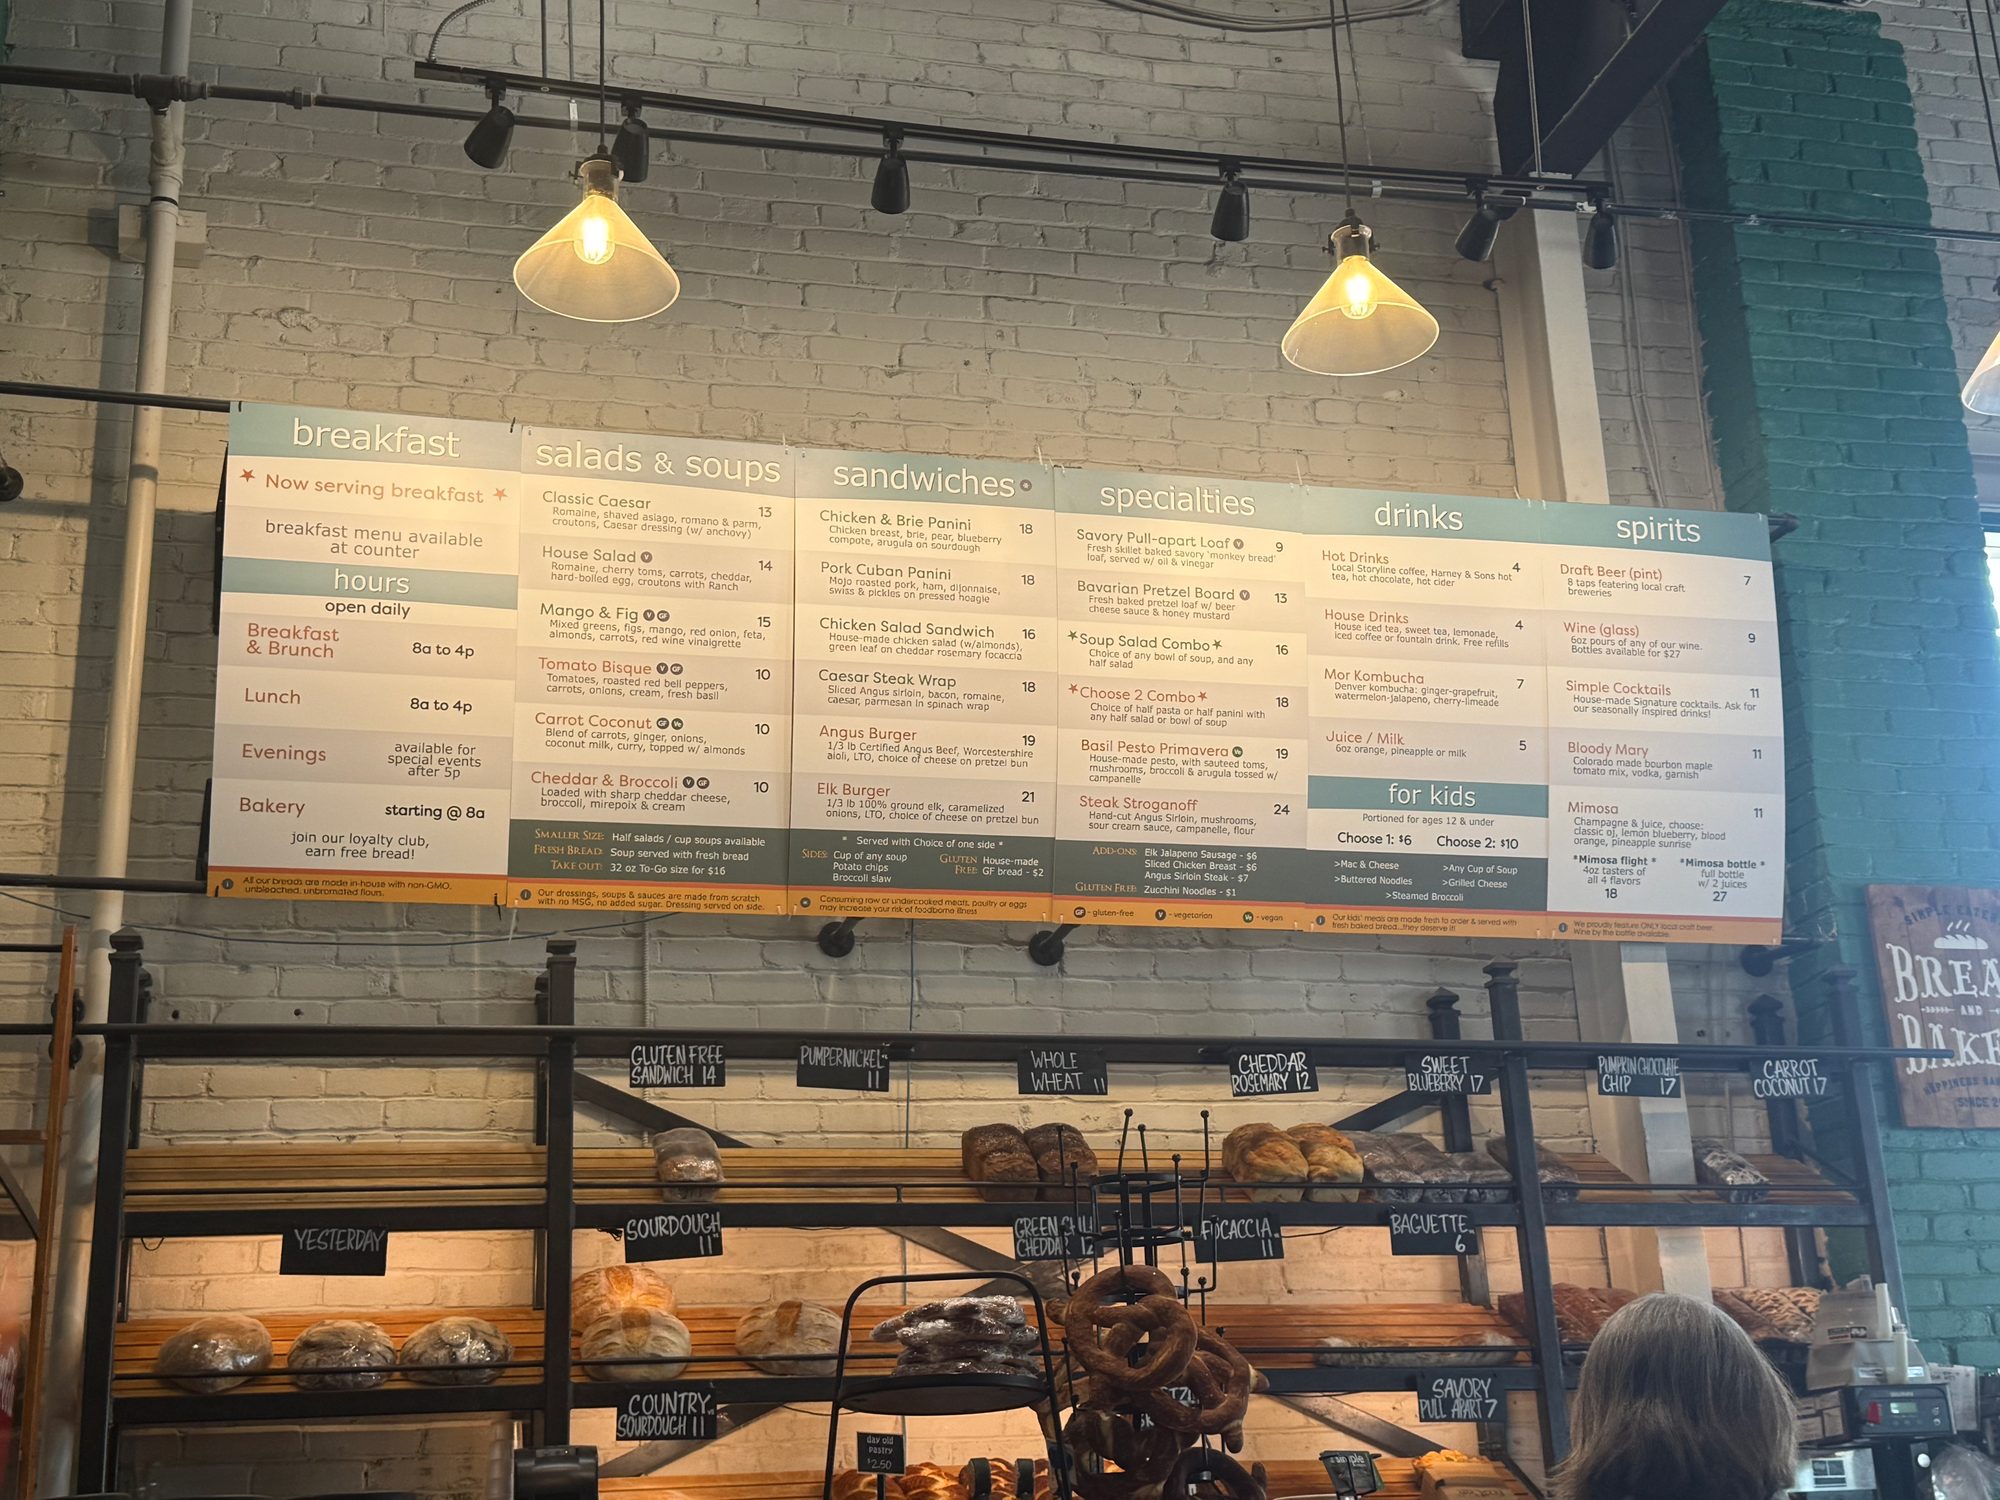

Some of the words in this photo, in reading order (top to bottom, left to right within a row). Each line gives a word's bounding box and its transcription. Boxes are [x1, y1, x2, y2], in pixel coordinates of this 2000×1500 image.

[293, 417, 460, 458] breakfast
[535, 440, 642, 473] salads
[654, 452, 675, 475] &
[686, 454, 781, 487] soups
[266, 474, 308, 490] Now
[315, 479, 384, 499] serving
[392, 483, 484, 503] breakfast
[833, 464, 1016, 498] sandwiches
[543, 491, 594, 506] Classic
[598, 495, 651, 509] Caesar
[1100, 485, 1256, 516] specialties
[759, 507, 772, 517] 13
[820, 510, 876, 524] Chicken
[880, 514, 892, 525] &
[897, 515, 923, 527] Brie
[928, 517, 971, 530] Panini
[1375, 501, 1464, 530] drinks
[1077, 529, 1123, 544] Savory
[1127, 532, 1196, 548] Pull-apart
[1201, 537, 1231, 549] Loaf
[1617, 516, 1701, 544] spirits
[543, 546, 588, 560] House
[593, 549, 636, 563] Salad
[1276, 542, 1283, 552] 9
[759, 560, 772, 571] 14
[1322, 550, 1345, 562] Hot
[1350, 552, 1389, 565] Drinks
[1512, 563, 1520, 572] 4
[1560, 564, 1593, 576] Draft
[1598, 566, 1626, 577] Beer
[1629, 567, 1662, 581] (pint)
[334, 568, 410, 594] hours
[1744, 575, 1751, 585] 7
[1077, 580, 1139, 595] Bavarian
[1144, 584, 1191, 598] Pretzel
[1195, 587, 1235, 600] Board
[325, 601, 366, 616] open
[371, 602, 411, 619] daily
[540, 603, 594, 618] Mango
[599, 606, 611, 618] &
[616, 607, 638, 622] Fig
[1325, 609, 1365, 622] House
[1369, 611, 1408, 624] Drinks
[248, 623, 339, 642] Breakfast
[246, 641, 261, 654] &
[269, 641, 334, 659] Brunch
[538, 657, 597, 672] Tomato
[602, 660, 652, 676] Bisque
[818, 669, 869, 683] Caesar
[873, 671, 915, 685] Steak
[918, 674, 956, 688] Wrap
[245, 688, 301, 704] Lunch
[1080, 686, 1130, 700] Choose
[1135, 689, 1143, 700] 2
[1147, 691, 1196, 703] Combo
[1566, 681, 1609, 694] Simple
[1613, 682, 1671, 696] Cocktails
[1750, 688, 1759, 698] 11
[535, 713, 584, 726] Carrot
[588, 715, 652, 729] Coconut
[819, 725, 864, 741] Angus
[869, 727, 917, 743] Burger
[1022, 735, 1035, 746] 19
[242, 744, 326, 765] Evenings
[1568, 742, 1611, 756] Bloody
[1616, 743, 1648, 758] Mary
[531, 771, 597, 786] Cheddar
[602, 775, 614, 786] &
[620, 774, 678, 789] Broccoli
[754, 781, 769, 793] 10
[817, 783, 838, 795] Elk
[842, 784, 890, 799] Burger
[1022, 792, 1035, 802] 21
[1389, 783, 1421, 804] for
[1430, 784, 1476, 807] kids
[239, 797, 305, 818] Bakery
[385, 804, 442, 820] starting
[447, 806, 462, 820] @
[466, 807, 485, 819] 8a
[1079, 796, 1119, 808] Steak
[1123, 797, 1198, 813] Stroganoff
[1274, 805, 1290, 815] 24
[1568, 802, 1618, 814] Mimosa
[612, 833, 630, 842] Half
[634, 834, 664, 843] salads
[675, 836, 691, 846] cup
[695, 836, 721, 847] soups
[725, 837, 765, 847] available
[1338, 832, 1383, 845] Choose
[1386, 834, 1394, 845] 1:
[1399, 834, 1411, 846] $6
[833, 851, 852, 861] Cup
[855, 851, 864, 860] of
[866, 853, 882, 862] any
[886, 854, 907, 862] soup
[1145, 849, 1158, 857] Elk
[1161, 850, 1198, 860] Jalapeno
[1201, 850, 1237, 861] Sausage
[1247, 852, 1257, 861] $6
[1379, 877, 1412, 885] Noodles
[1960, 1005, 1983, 1016] AND
[631, 1045, 686, 1066] GLUTEN
[689, 1045, 724, 1065] FREE
[800, 1045, 885, 1068] PUMPERNICKEL
[1031, 1051, 1078, 1069] WHOLE
[1239, 1052, 1308, 1075] CHEDDAR
[1421, 1055, 1470, 1074] SWEET
[632, 1064, 694, 1085] SANDWICH
[702, 1064, 716, 1085] 14
[1598, 1056, 1637, 1075] PUMPKIN
[1638, 1057, 1680, 1077] CHOCOLATE
[1763, 1059, 1818, 1079] CARROT
[868, 1070, 879, 1088] 11
[1031, 1072, 1083, 1092] WHEAT
[1232, 1072, 1288, 1094] ROSEMARY
[1296, 1072, 1311, 1091] 12
[1408, 1073, 1465, 1092] BLUEBERRY
[1470, 1075, 1484, 1092] 17
[1602, 1074, 1631, 1092] CHIP
[1660, 1077, 1676, 1095] 17
[1754, 1078, 1812, 1098] COCONUT
[1814, 1077, 1827, 1095] 17
[625, 1212, 721, 1241] SOURDOUGH
[1015, 1216, 1058, 1238] GREEN
[1200, 1218, 1272, 1240] FOCACCIA
[1390, 1213, 1468, 1234] BAGUETTE
[294, 1229, 386, 1251] YESTERDAY
[1017, 1237, 1071, 1257] CHEDDAR
[1081, 1237, 1094, 1255] 12
[1455, 1234, 1466, 1252] 6
[1432, 1377, 1491, 1399] SAVORY
[628, 1391, 711, 1416] COUNTRY
[1419, 1398, 1446, 1419] PULL
[1451, 1398, 1483, 1419] APART
[1484, 1399, 1498, 1418] 7
[617, 1414, 686, 1437] SOURDOUGH
[867, 1435, 880, 1444] day
